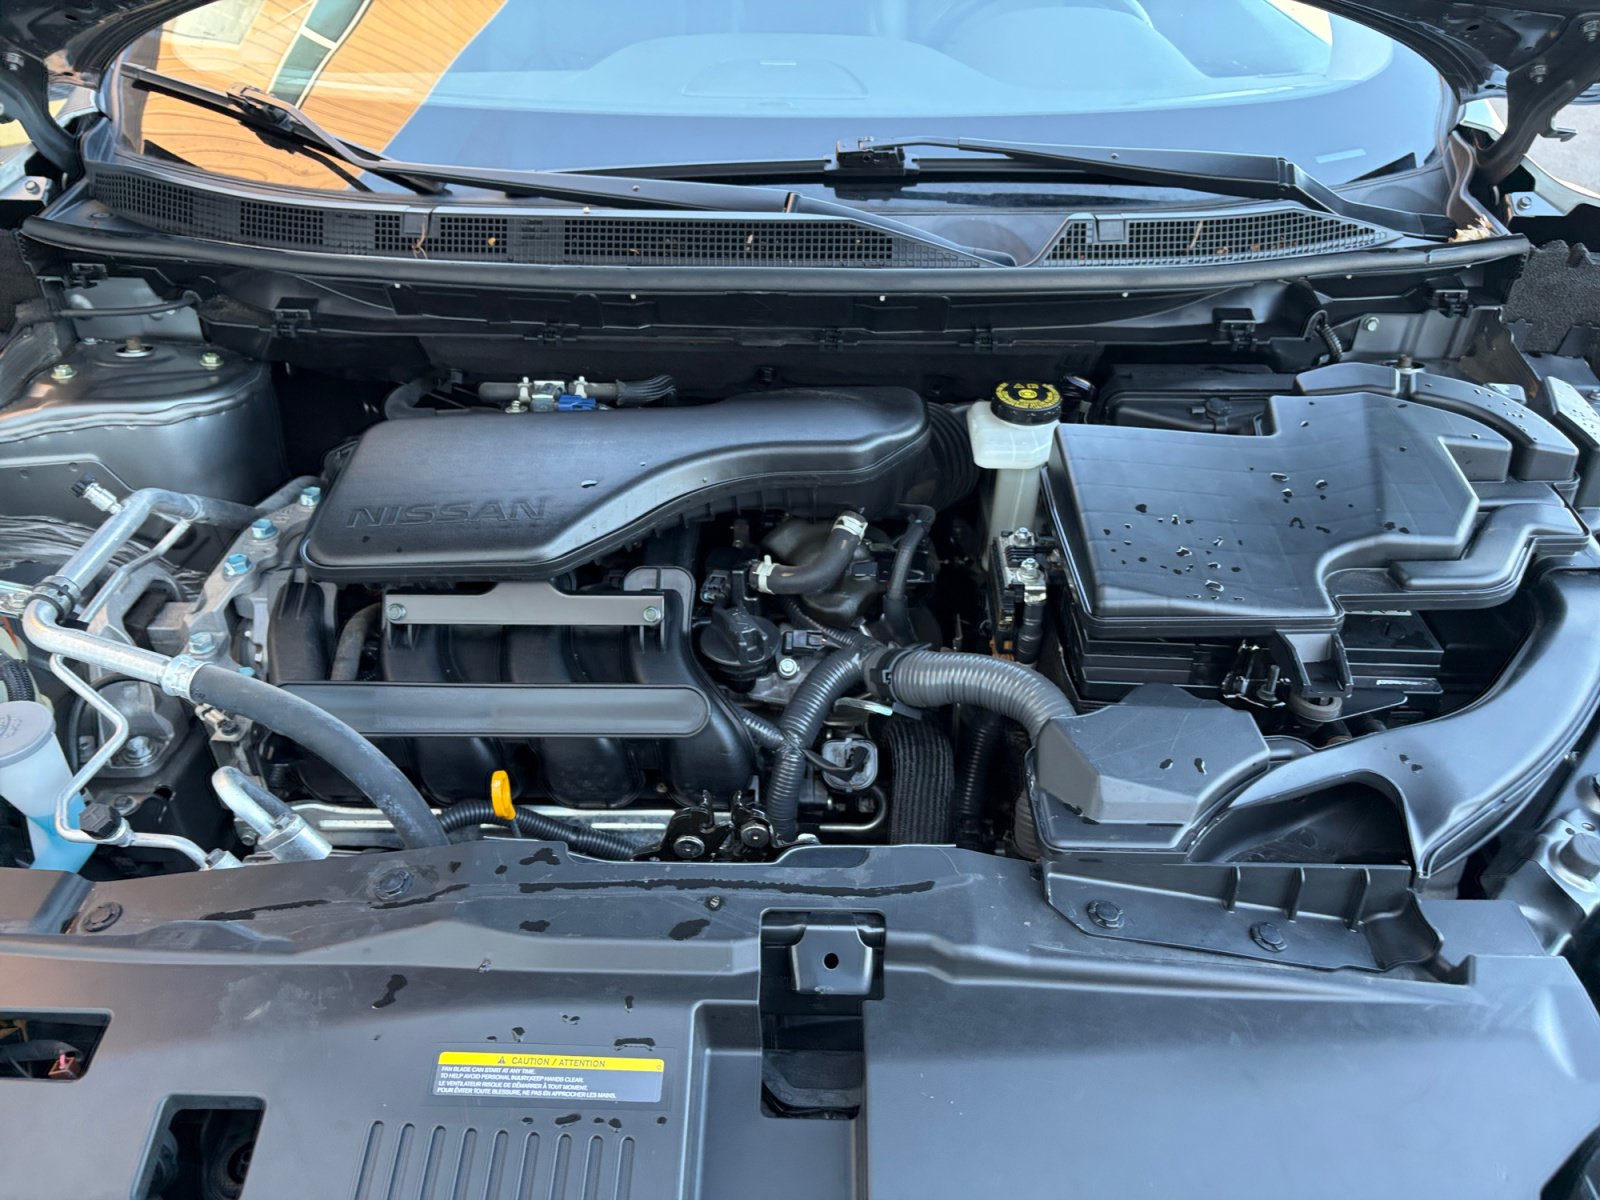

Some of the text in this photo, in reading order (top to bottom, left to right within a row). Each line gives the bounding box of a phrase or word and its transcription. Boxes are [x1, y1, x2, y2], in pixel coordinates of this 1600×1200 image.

[346, 496, 549, 528] NISSAN
[511, 1056, 606, 1068] CAUTION / ATTENTION
[454, 1086, 473, 1094] ÉVITER
[511, 1081, 543, 1089] DÉMARRER
